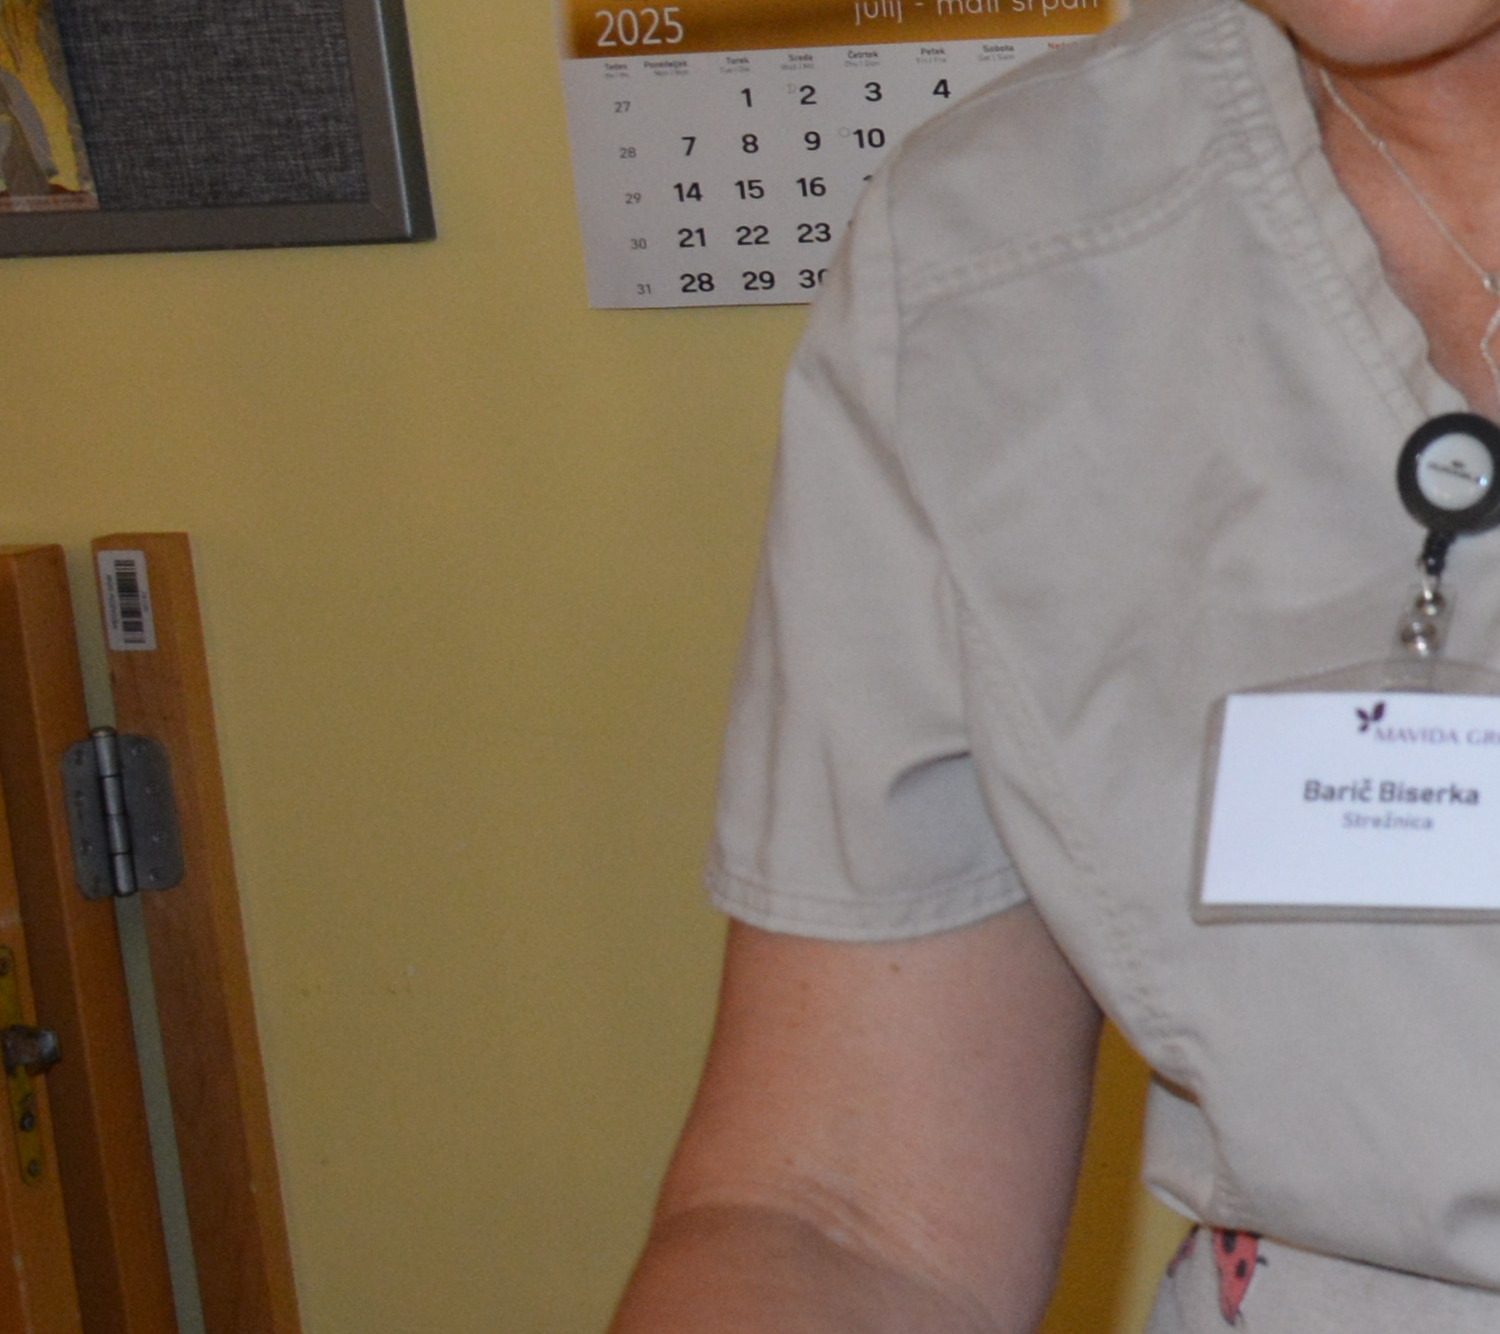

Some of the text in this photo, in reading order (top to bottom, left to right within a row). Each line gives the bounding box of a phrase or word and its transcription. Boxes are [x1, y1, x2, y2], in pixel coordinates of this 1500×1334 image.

[595, 7, 684, 47] 2025
[614, 79, 951, 113] 27 1 2 3 4
[619, 128, 885, 159] 28 7 8 9 10
[625, 177, 826, 205] 29 14 15 16
[630, 222, 832, 250] 30 21 22 23
[637, 283, 651, 295] 31
[680, 272, 715, 293] 28
[741, 270, 775, 291] 29
[1374, 727, 1460, 745] MAVIDA
[1304, 777, 1480, 806] Barič Biserka
[1342, 811, 1434, 830] Strežnica
